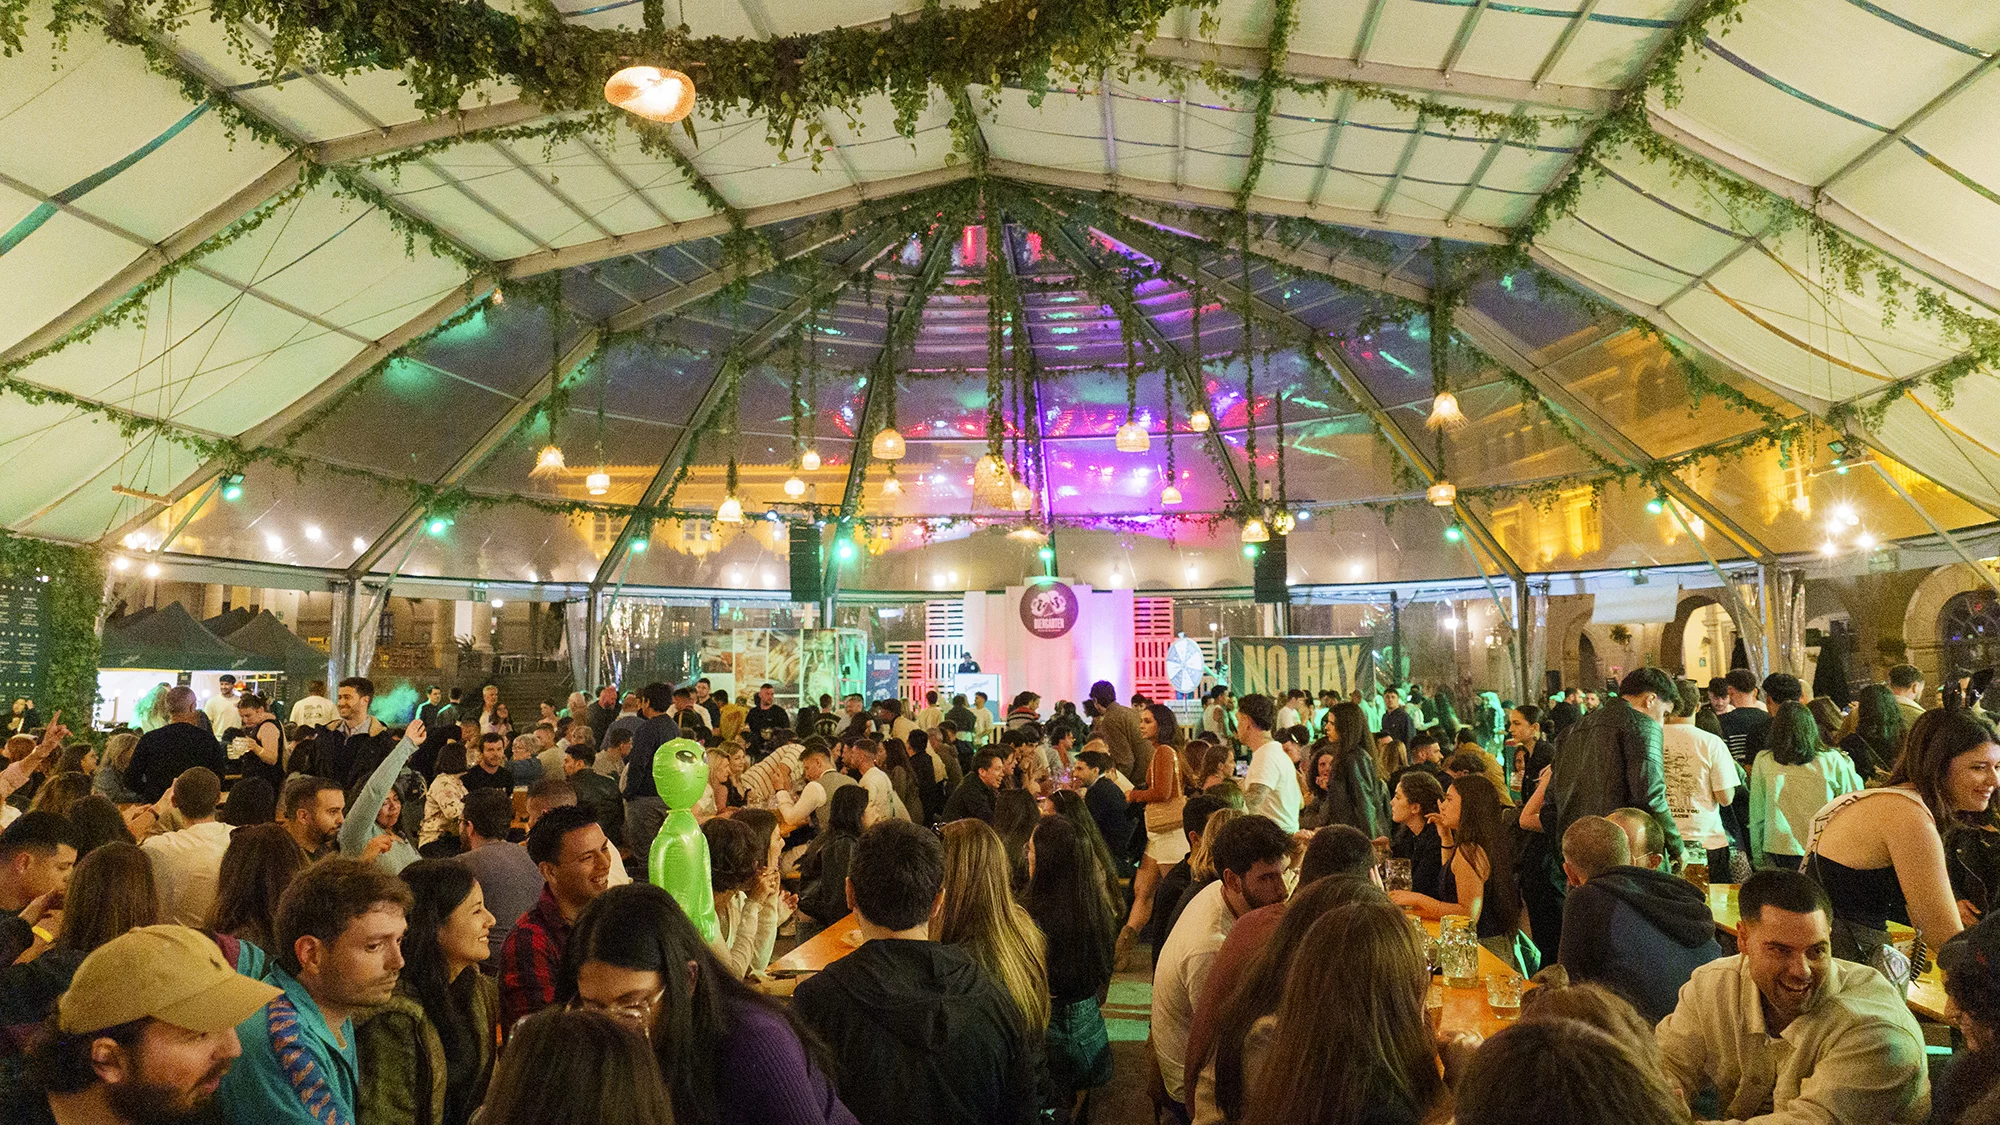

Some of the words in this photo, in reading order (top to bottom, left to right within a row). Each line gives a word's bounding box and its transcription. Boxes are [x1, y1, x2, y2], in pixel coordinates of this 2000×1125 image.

[1033, 618, 1065, 629] BIERGARTEN
[1243, 645, 1288, 698] NO
[1298, 644, 1361, 699] HAY
